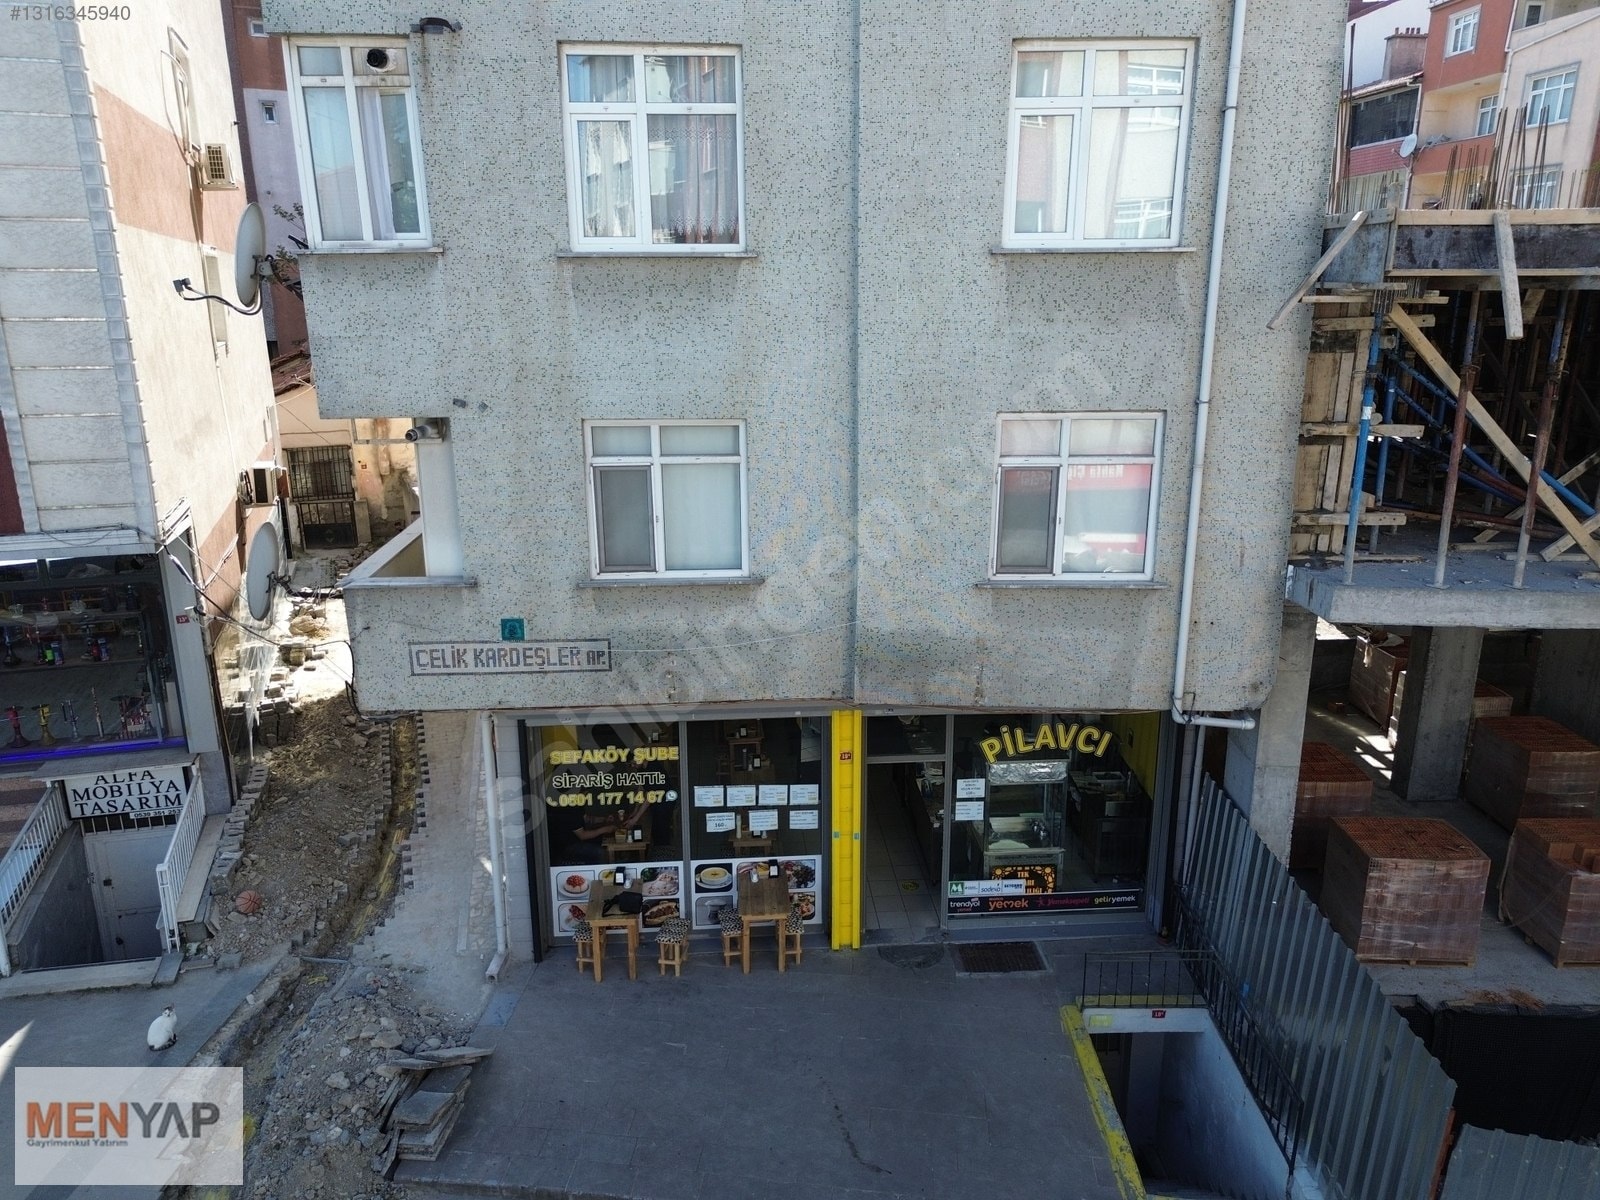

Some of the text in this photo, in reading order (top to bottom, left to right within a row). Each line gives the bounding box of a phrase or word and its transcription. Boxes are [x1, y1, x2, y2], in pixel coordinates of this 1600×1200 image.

[414, 645, 606, 671] ÇELİK KARDEŞLER AP.
[978, 722, 1113, 764] PİLAVCI
[549, 745, 680, 767] SEFAKÖY ŞUBE
[94, 769, 156, 785] ALFA
[552, 770, 666, 790] SİPARİŞ HATTI:
[71, 779, 181, 803] MOBILYA
[597, 791, 624, 805] 177
[626, 790, 645, 804] 14
[74, 792, 183, 817] TASARIM
[949, 899, 980, 909] trendyol
[988, 898, 1029, 911] yemek
[1093, 895, 1136, 905] getiryemek
